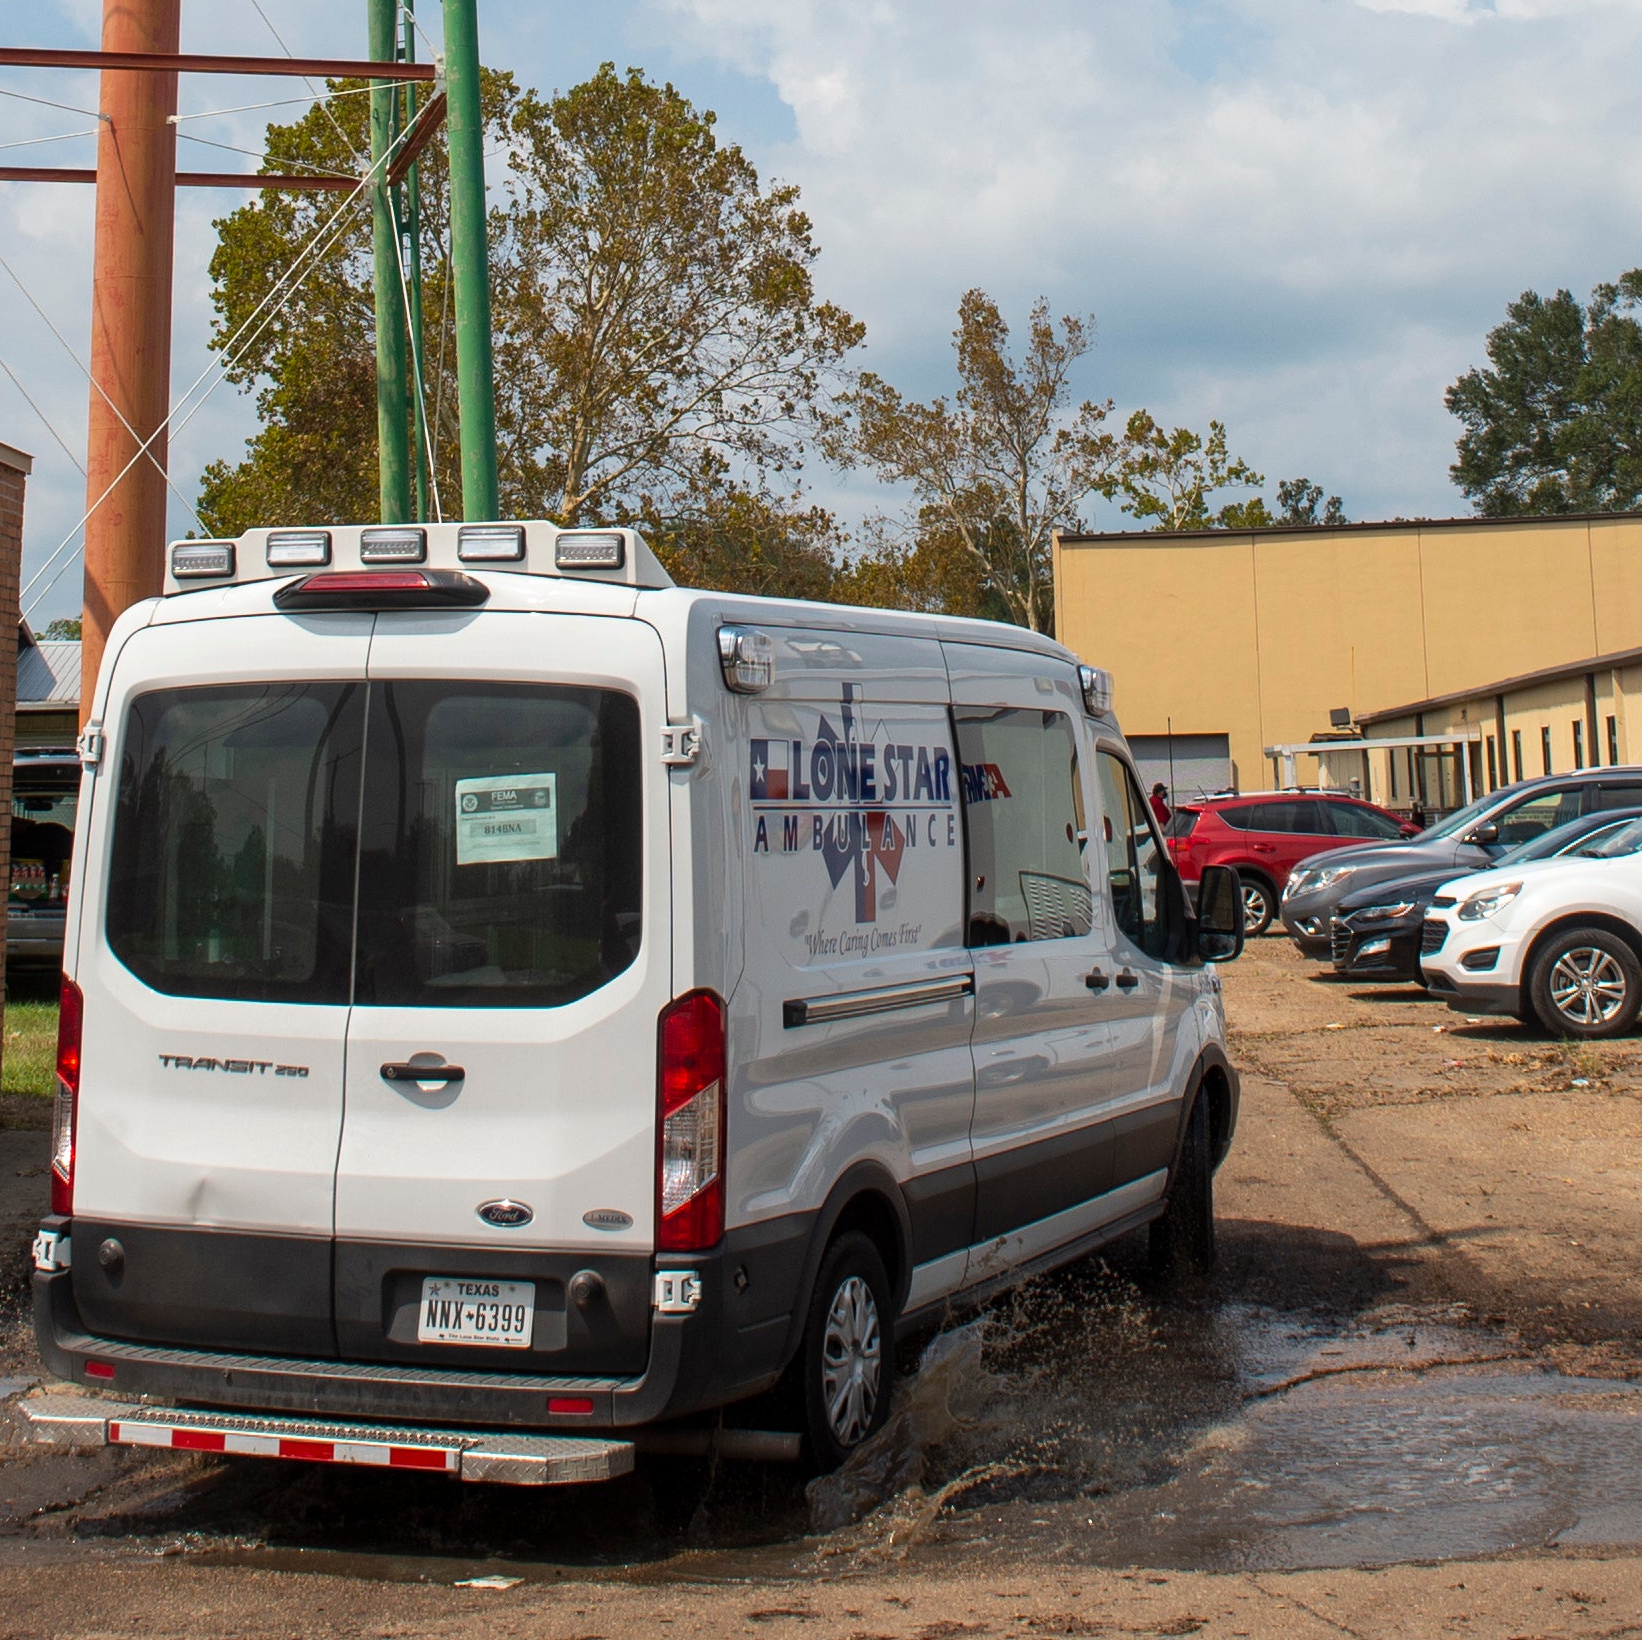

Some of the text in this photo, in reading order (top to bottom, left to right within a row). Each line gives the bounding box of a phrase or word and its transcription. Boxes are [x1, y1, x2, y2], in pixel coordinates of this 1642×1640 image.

[792, 739, 951, 802] LONE STAR
[491, 790, 517, 801] FEMA
[754, 813, 956, 853] AMBULANCE
[839, 928, 869, 958] Caring
[871, 927, 897, 952] Comes
[158, 1054, 273, 1075] TRANSIT
[488, 1206, 520, 1222] Ford
[458, 1282, 500, 1298] TEXAS
